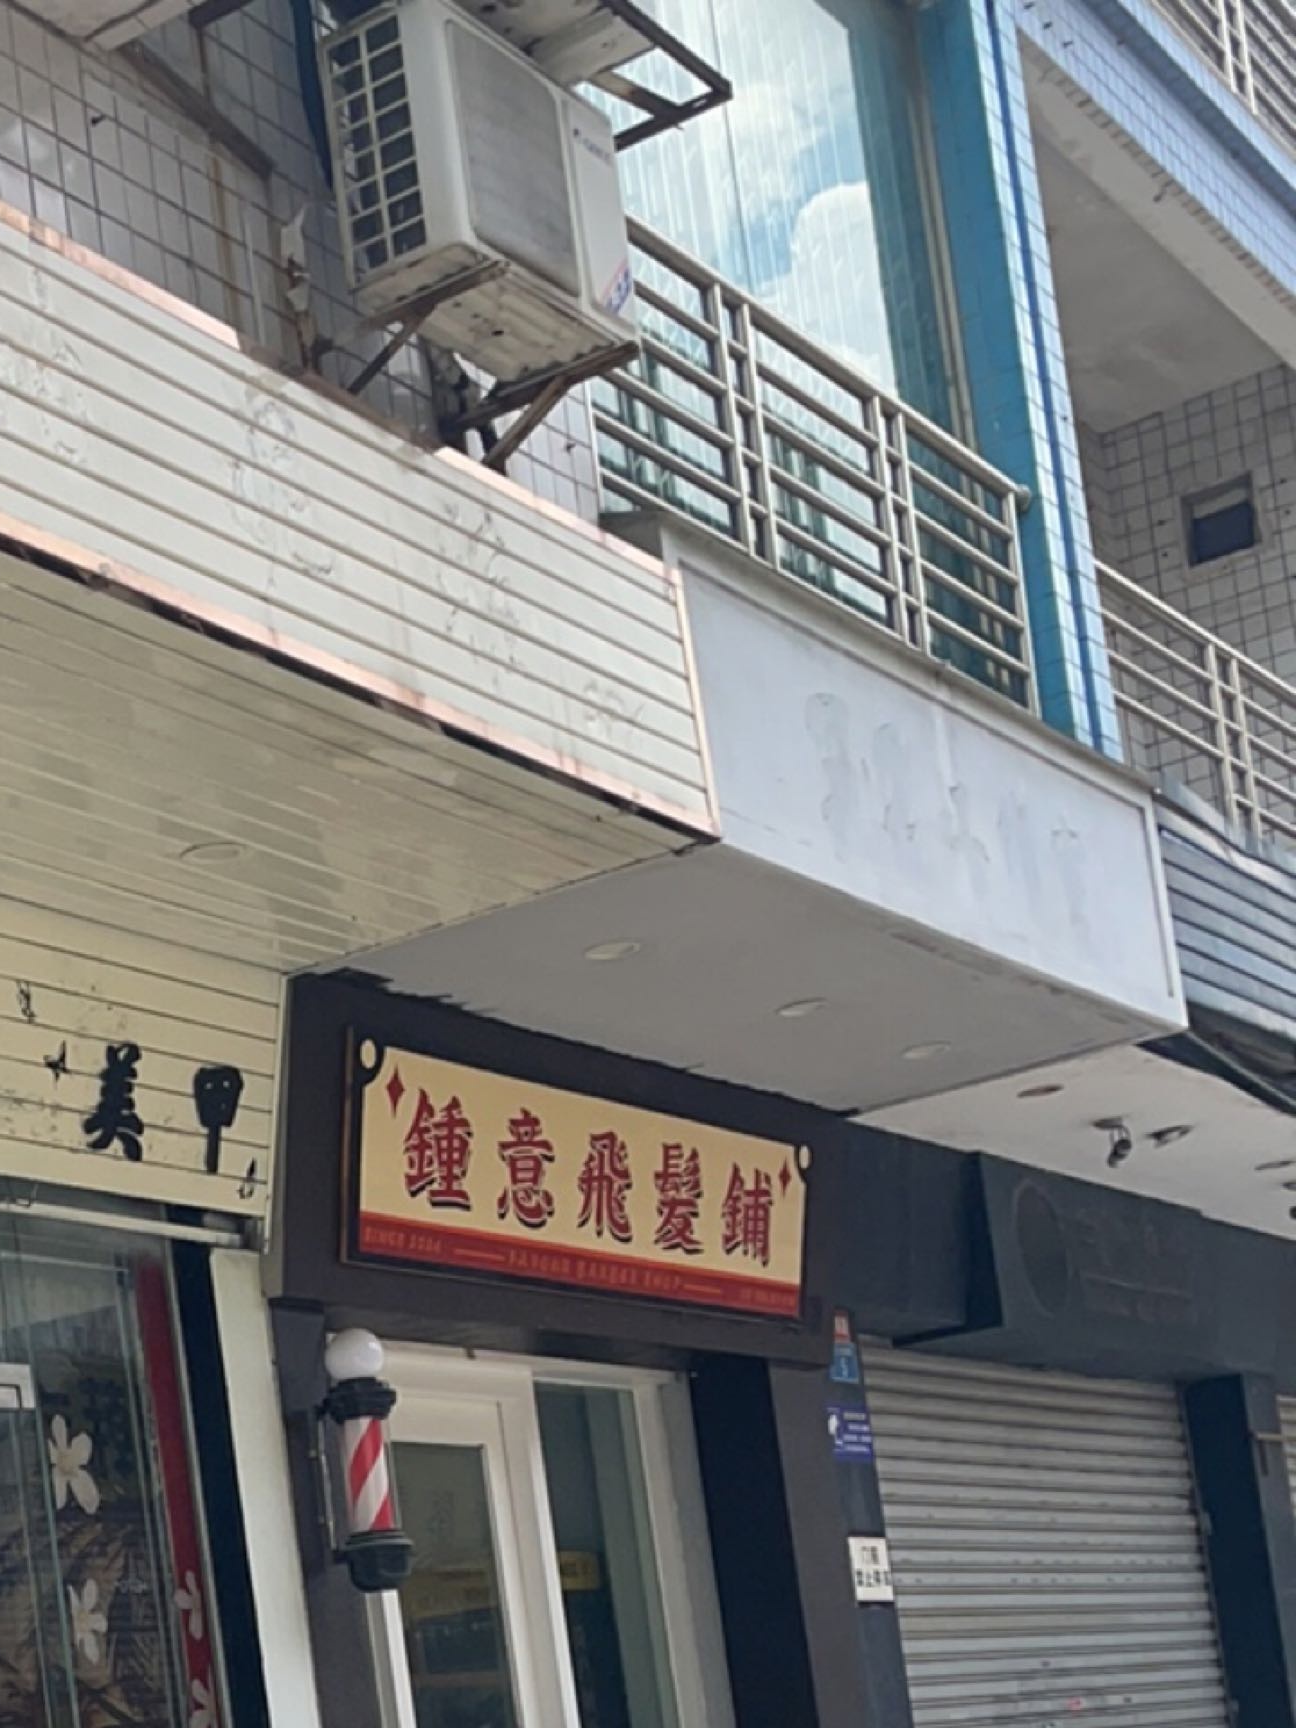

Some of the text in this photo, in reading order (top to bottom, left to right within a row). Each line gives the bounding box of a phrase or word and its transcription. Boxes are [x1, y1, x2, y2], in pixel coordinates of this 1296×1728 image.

[83, 1042, 244, 1175] 美甲
[404, 1088, 774, 1267] 鍾意飛髮鋪
